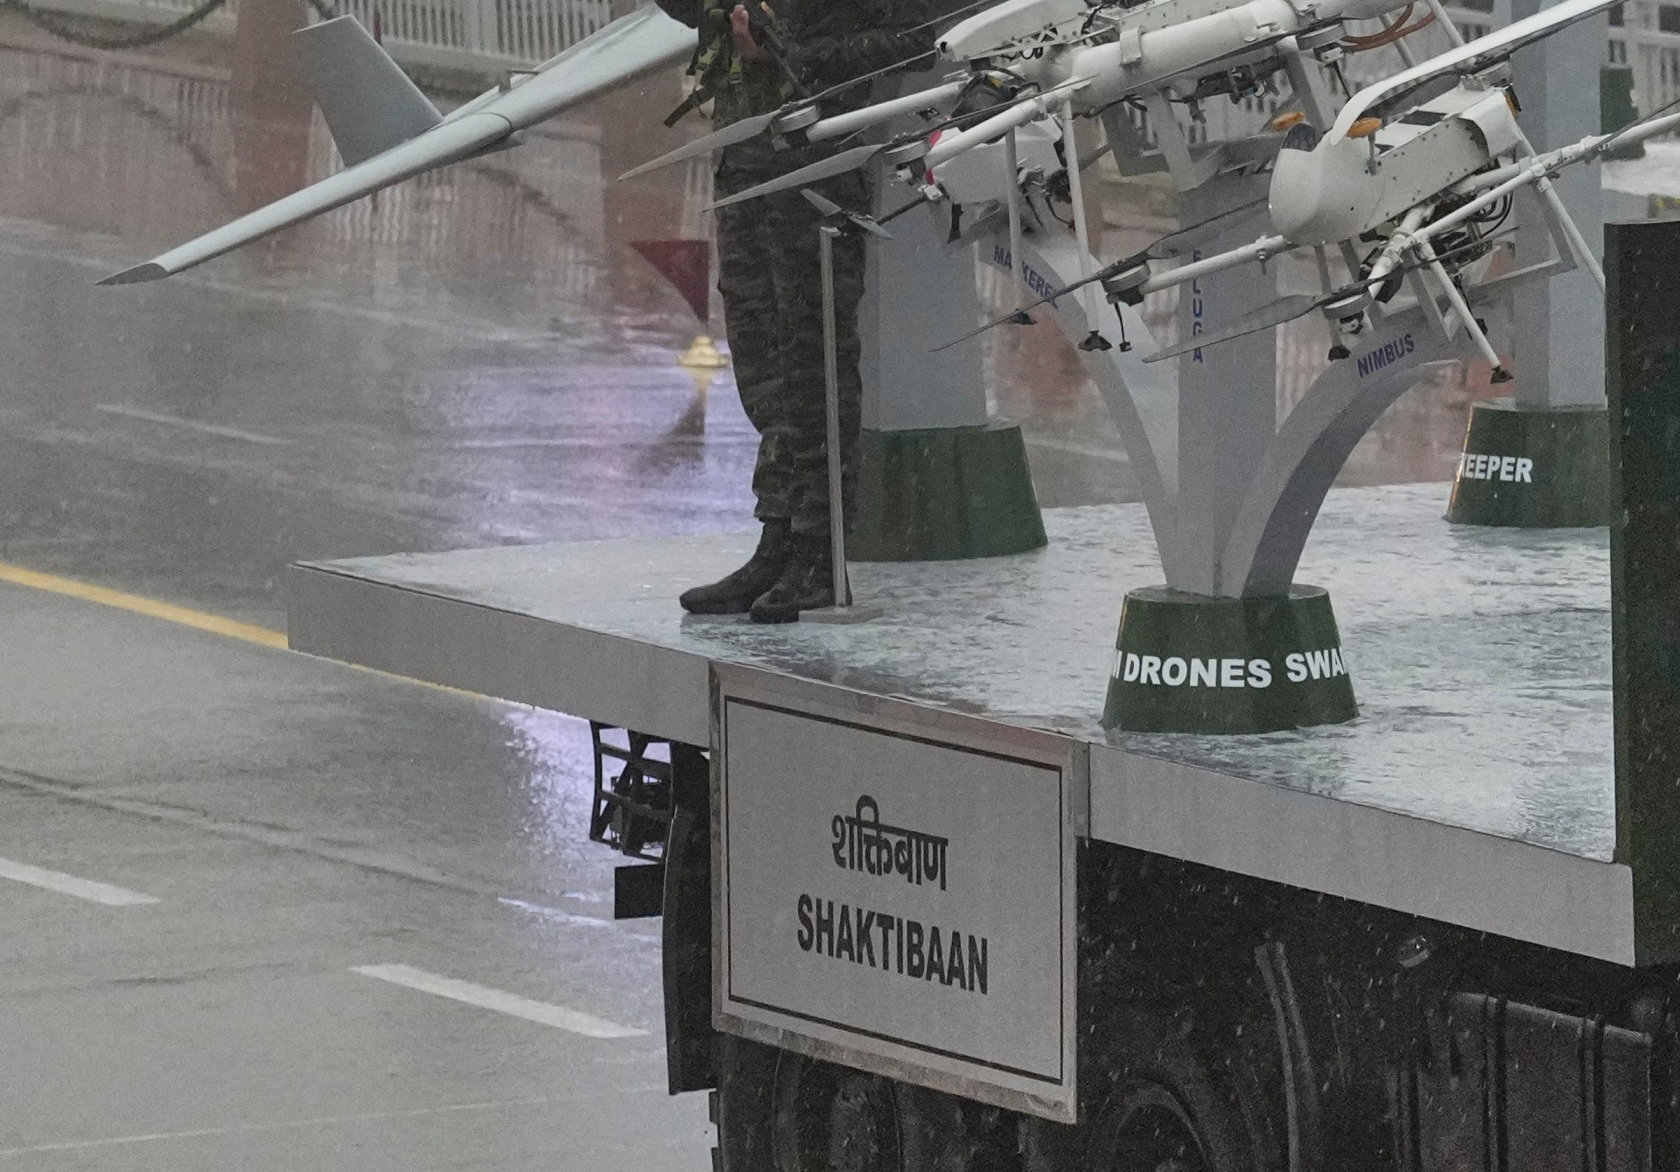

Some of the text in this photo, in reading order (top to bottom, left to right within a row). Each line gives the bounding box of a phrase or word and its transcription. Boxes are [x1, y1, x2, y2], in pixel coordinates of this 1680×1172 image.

[993, 244, 1058, 310] MAKEREL
[1357, 333, 1415, 378] NIMBUS
[1123, 653, 1273, 689] DRONES
[1285, 647, 1348, 683] SWA
[831, 794, 949, 892] शक्तिबाण
[797, 893, 988, 996] SHAKTIBAAN
